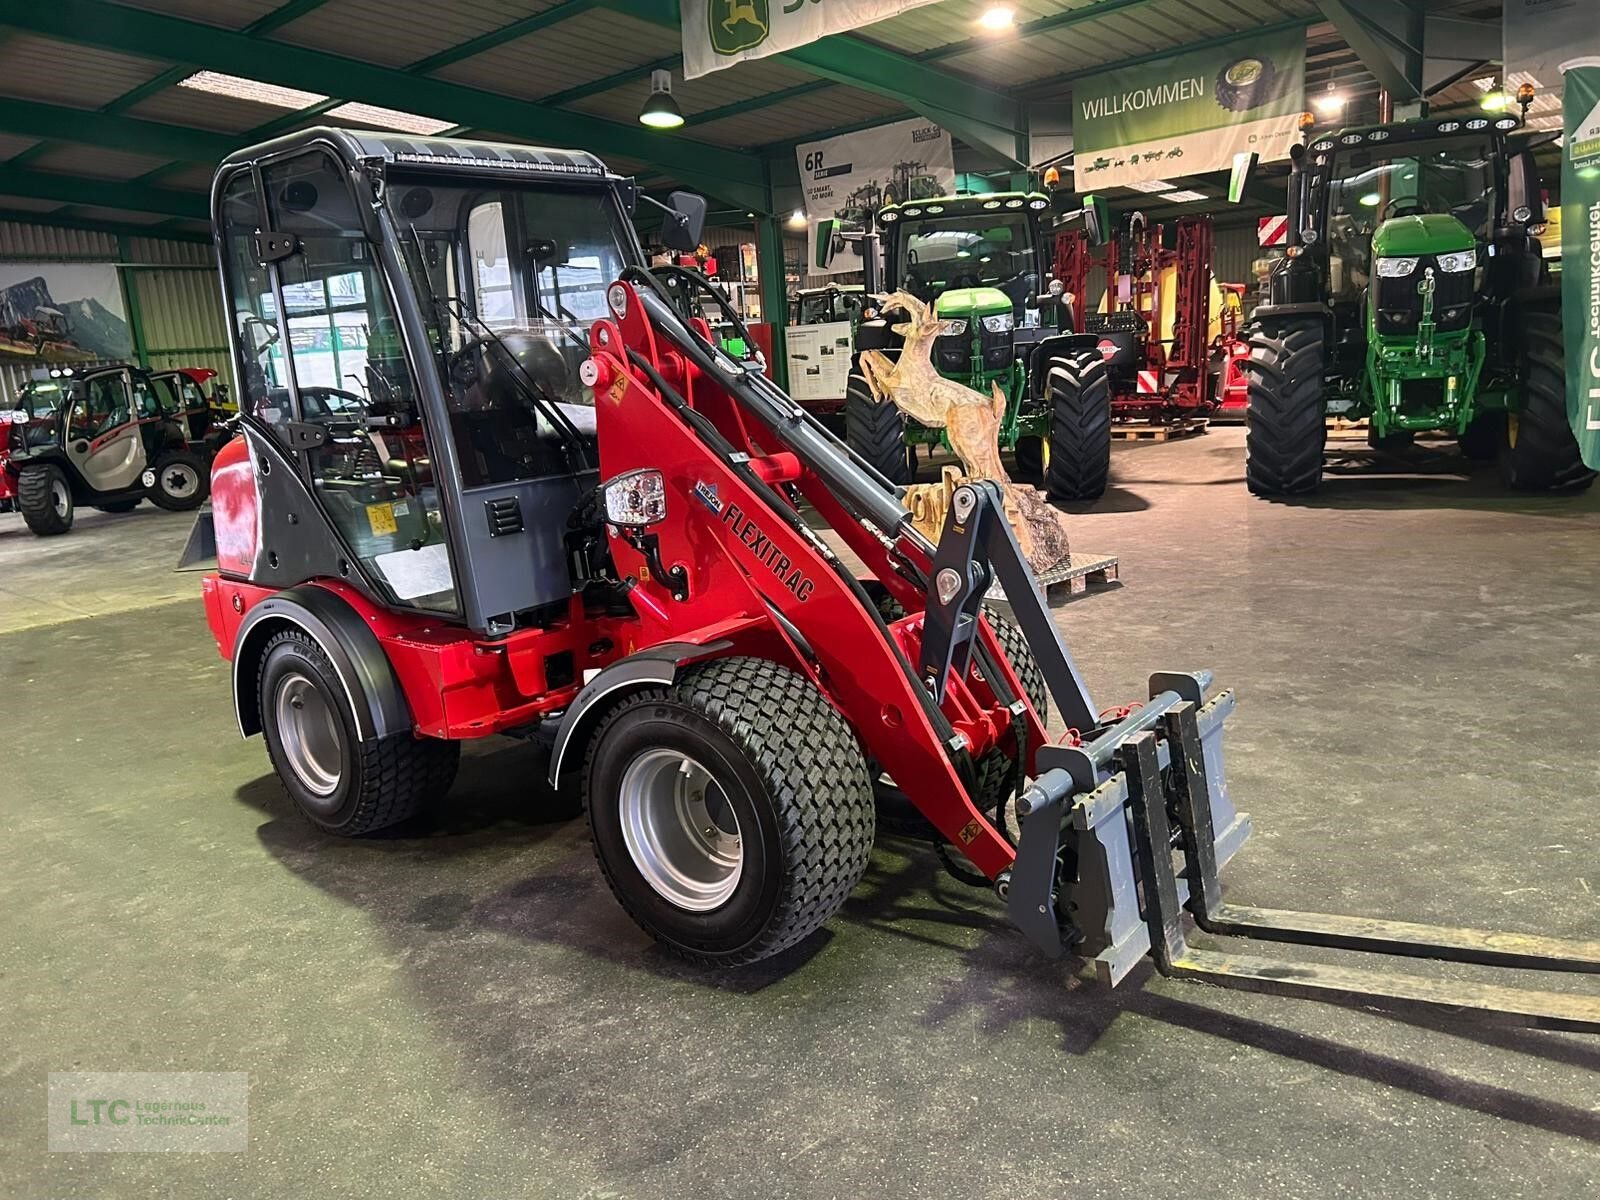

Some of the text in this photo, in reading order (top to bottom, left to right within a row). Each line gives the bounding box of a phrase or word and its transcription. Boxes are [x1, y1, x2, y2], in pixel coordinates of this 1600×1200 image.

[1082, 76, 1204, 120] WILLKOMMEN
[805, 151, 824, 171] 6R
[697, 481, 722, 511] TREJON
[722, 503, 814, 601] FLEXITRAC
